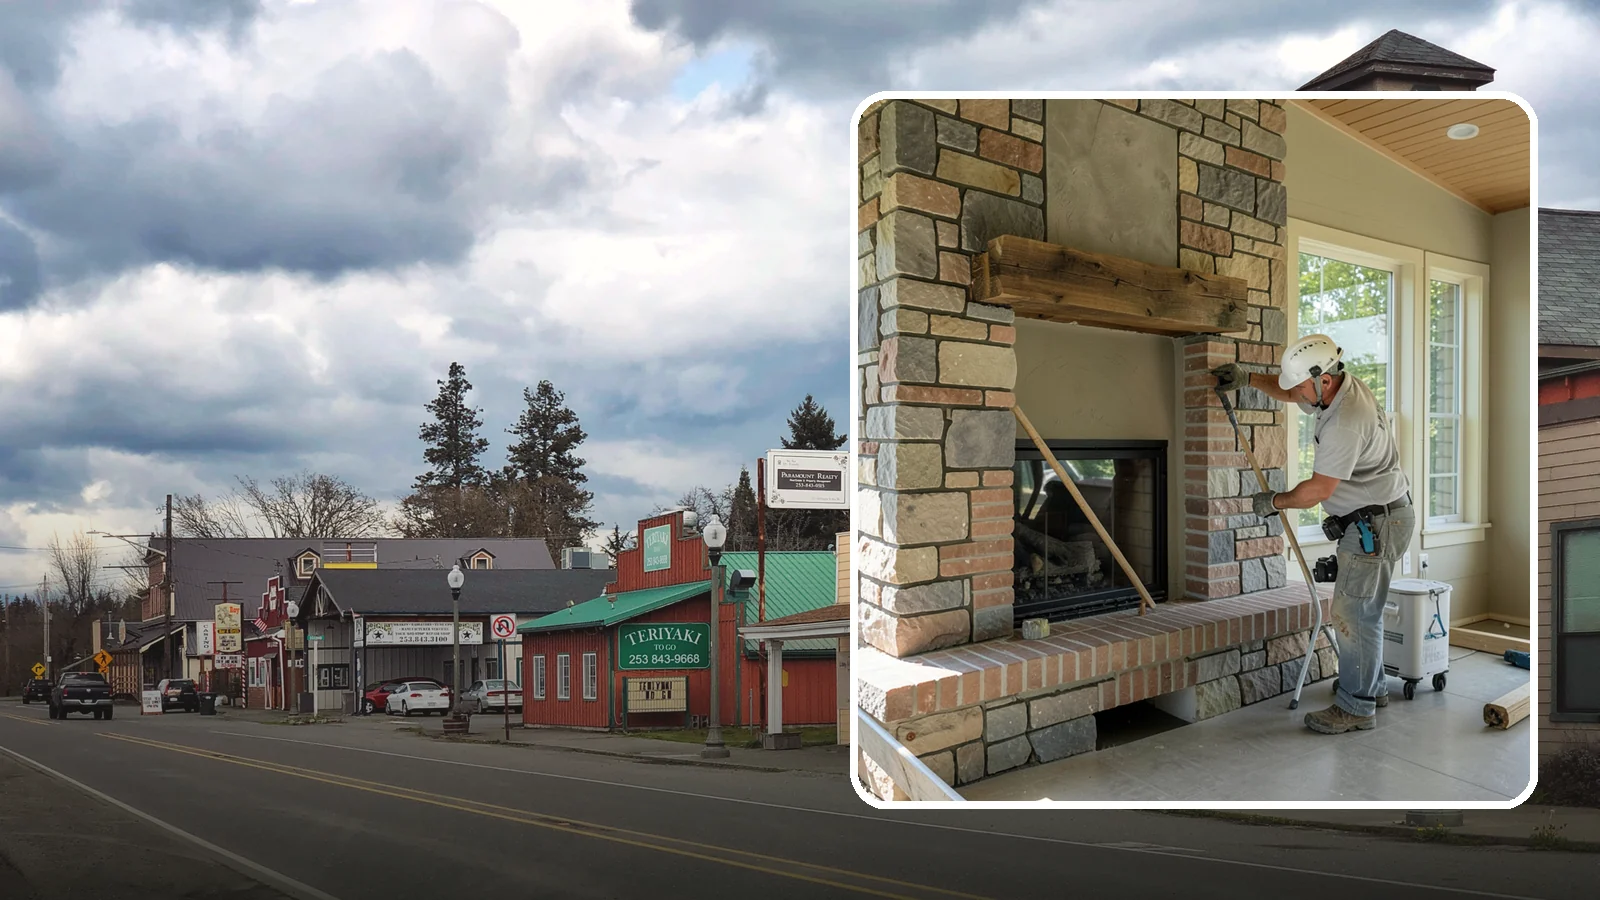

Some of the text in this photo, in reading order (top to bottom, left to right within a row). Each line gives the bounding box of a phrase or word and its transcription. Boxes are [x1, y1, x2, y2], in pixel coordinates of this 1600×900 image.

[817, 472, 839, 480] REALTY
[625, 628, 702, 646] TERIYAKI
[629, 654, 700, 665] 253 843-9668
